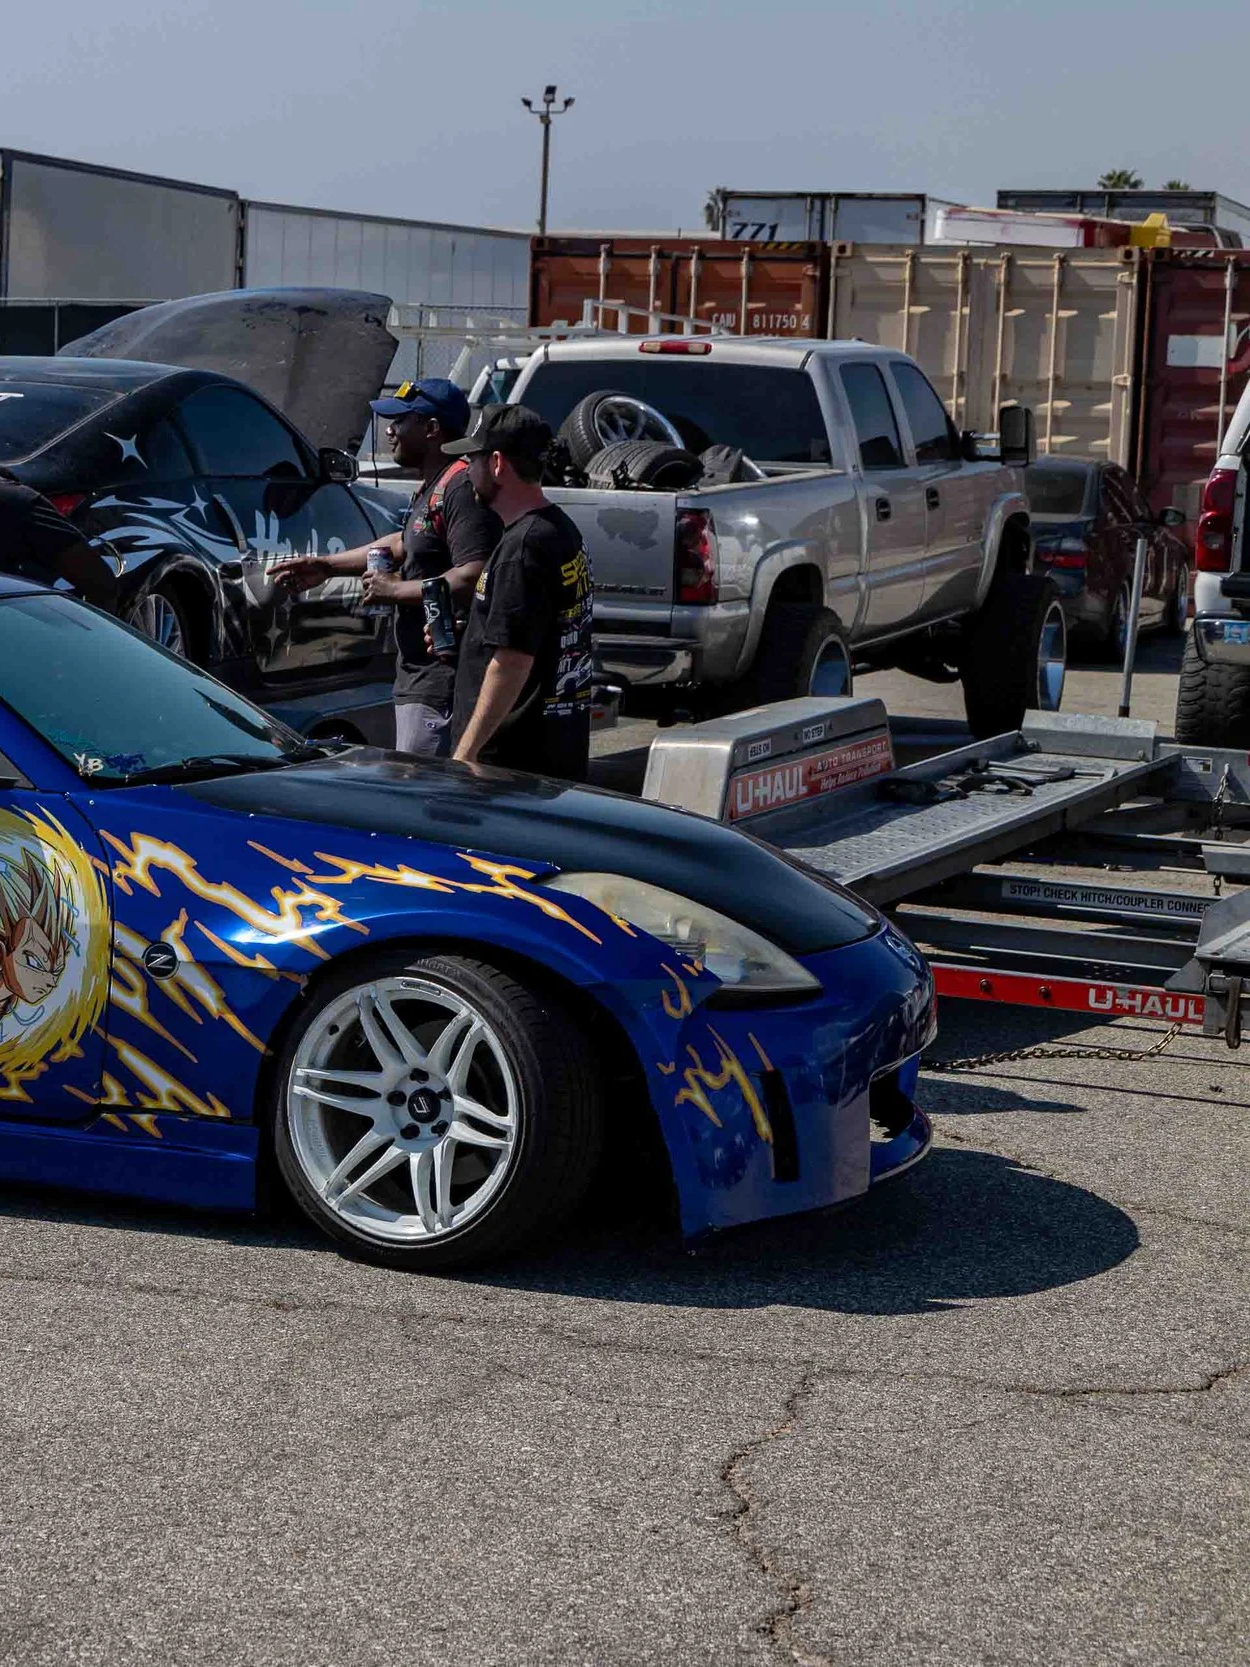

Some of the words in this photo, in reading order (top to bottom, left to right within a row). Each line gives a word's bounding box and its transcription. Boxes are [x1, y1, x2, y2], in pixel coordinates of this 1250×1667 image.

[732, 222, 779, 241] 771
[753, 314, 797, 329] 811750
[801, 314, 811, 329] 4
[817, 756, 839, 771] AUTO
[841, 741, 887, 761] TRANSPORT
[736, 766, 809, 813] U-HAUL
[1009, 884, 1041, 897] STOP!
[1043, 887, 1078, 901] CHECK
[1081, 891, 1164, 910] HITCH/COUPLER
[1088, 988, 1203, 1021] U-HAUL
